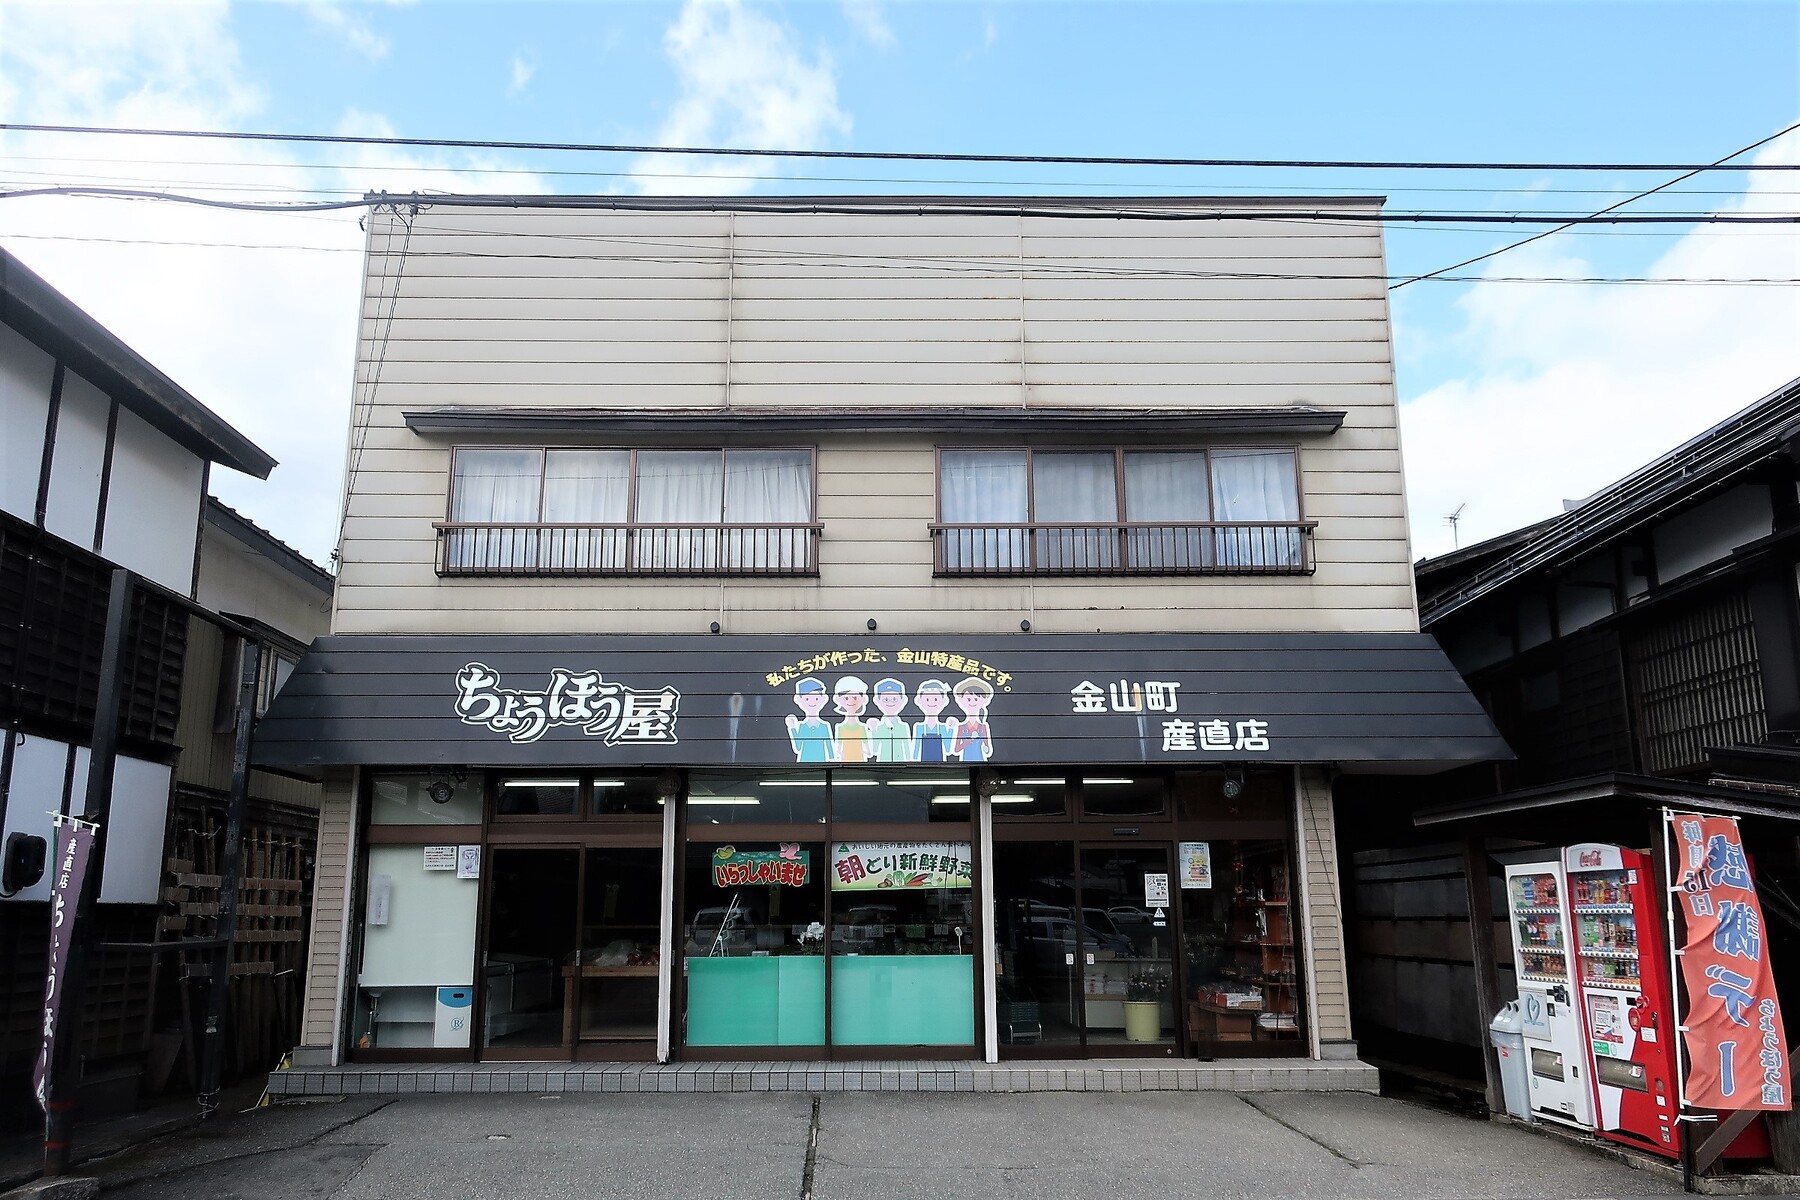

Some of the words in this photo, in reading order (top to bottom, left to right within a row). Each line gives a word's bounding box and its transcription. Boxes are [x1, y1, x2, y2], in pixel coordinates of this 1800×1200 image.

[1070, 679, 1181, 713] 金山町
[1161, 718, 1270, 752] 産直店
[58, 838, 77, 889] 産直店
[715, 860, 807, 887] いらっしゃいませ
[834, 853, 972, 884] 朝どり新鮮野菜
